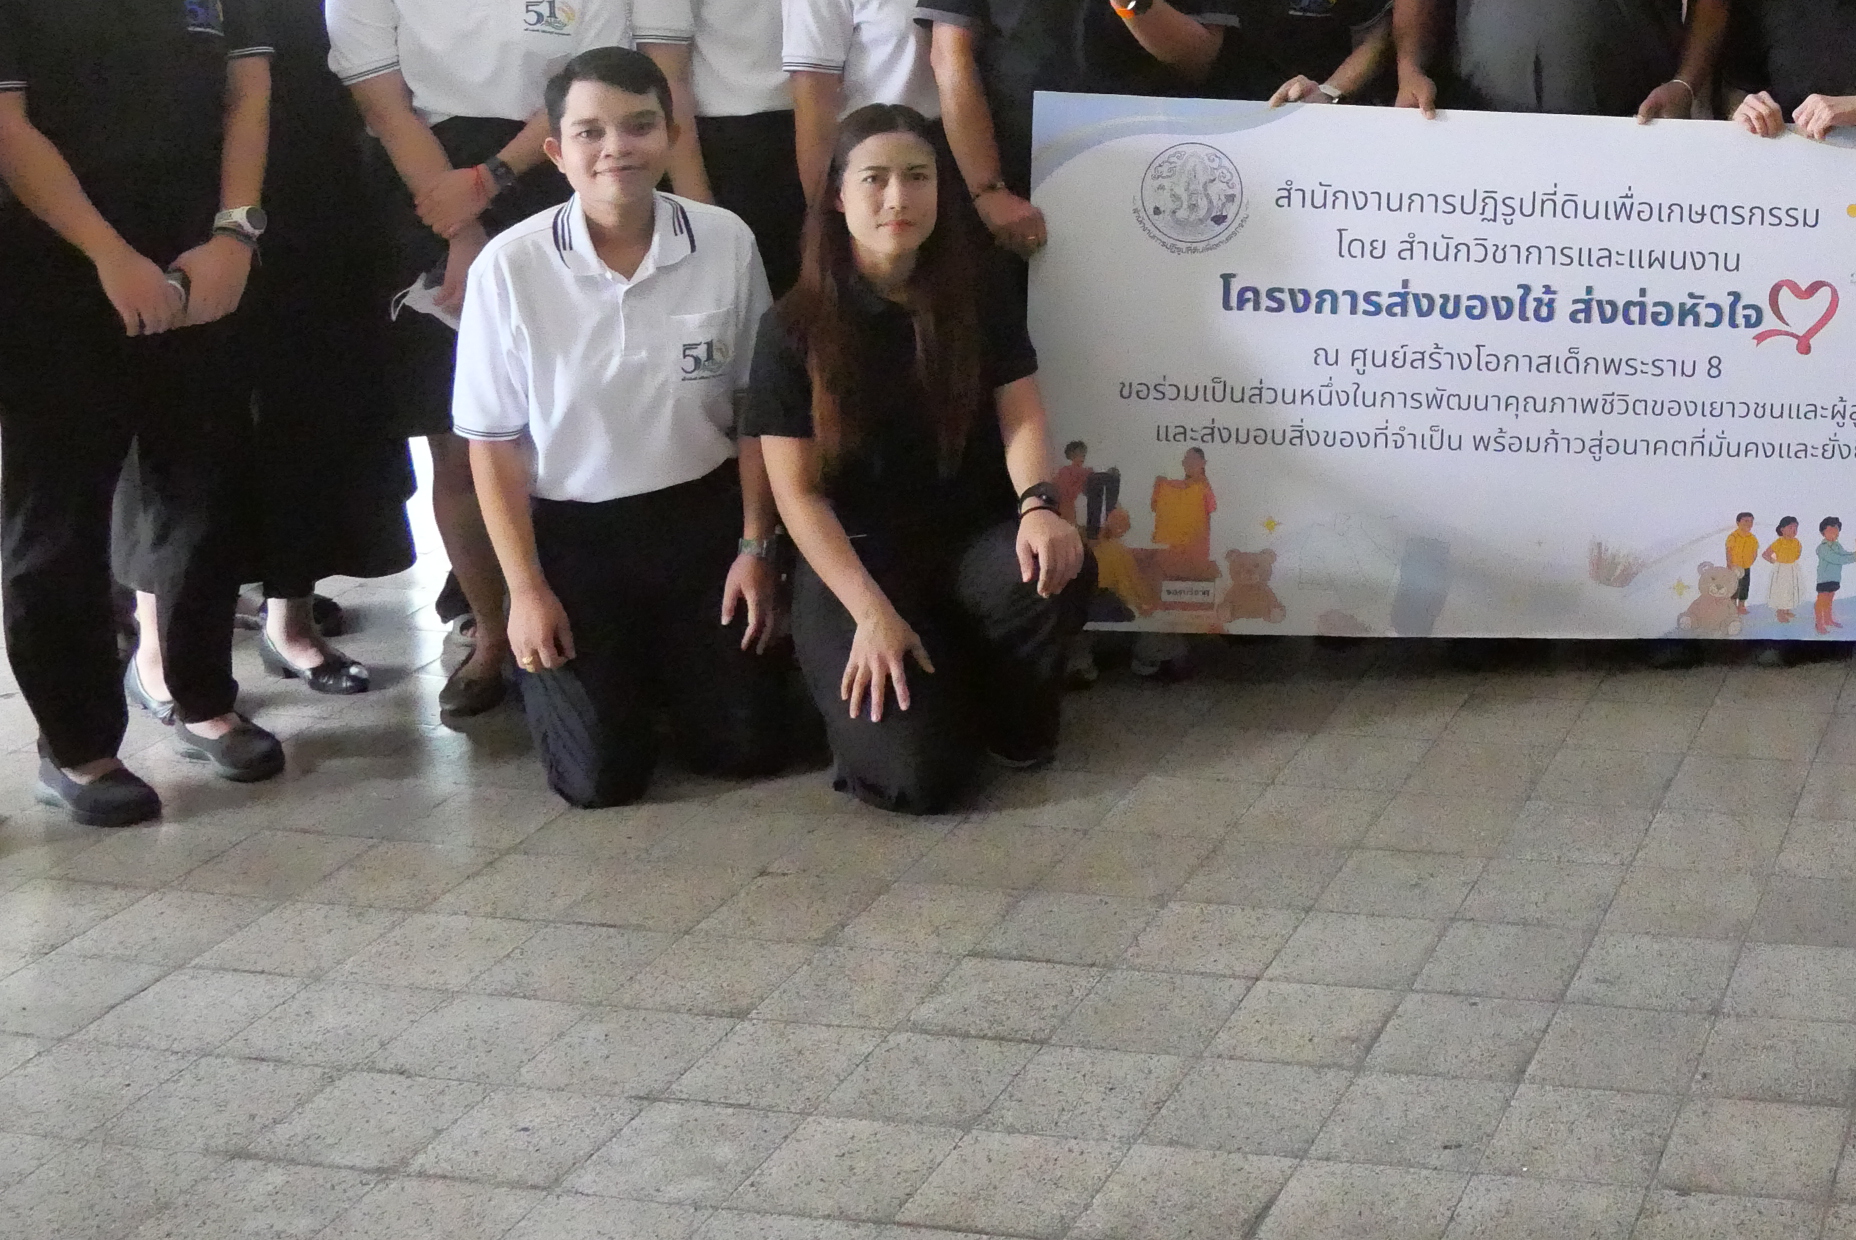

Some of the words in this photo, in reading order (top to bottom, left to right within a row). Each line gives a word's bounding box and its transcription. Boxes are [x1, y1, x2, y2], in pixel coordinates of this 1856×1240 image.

[523, 0, 558, 26] 51
[1274, 179, 1820, 228] สำนักงานการปฏิรูปที่ดินเพื่อเกษตรกรรม
[1336, 228, 1387, 259] โดย
[1397, 232, 1741, 272] สำนักวิชาการและแผนงาน
[1219, 272, 1558, 323] โครงการส่งของใช้
[1568, 285, 1764, 329] ส่งต่อหัวใจ
[681, 339, 713, 374] 51
[1313, 346, 1340, 366] ณ
[1350, 342, 1697, 378] ศูนย์สร้างโอกาสเด็กพระราม
[1706, 355, 1722, 378] 8
[1155, 418, 1462, 452] และส่งมอบสิ่งของที่จำเป็น
